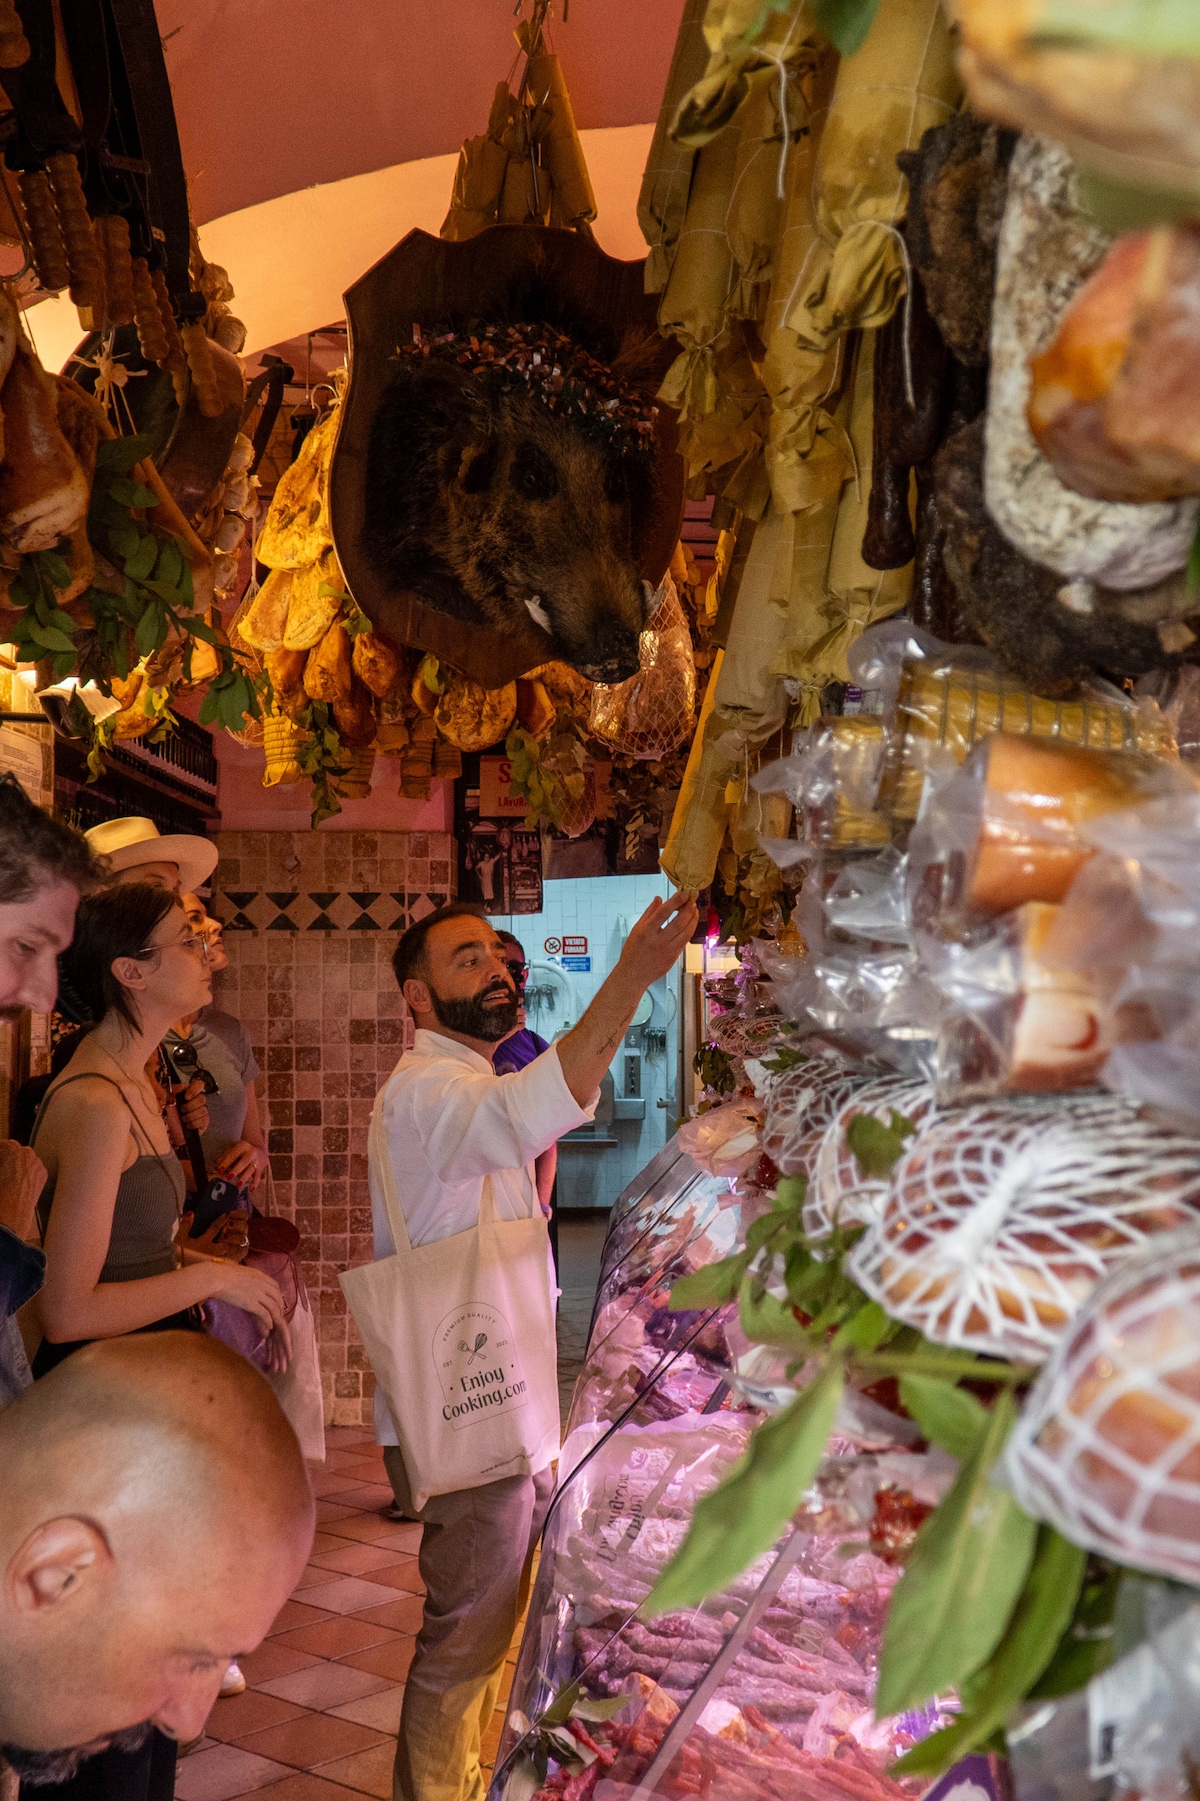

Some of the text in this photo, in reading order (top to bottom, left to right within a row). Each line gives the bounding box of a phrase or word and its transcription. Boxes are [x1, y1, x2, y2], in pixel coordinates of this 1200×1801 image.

[442, 1312, 496, 1342] PREMIUM QUALITY
[460, 1367, 505, 1392] Enjoy
[442, 1380, 527, 1421] Cooking.com
